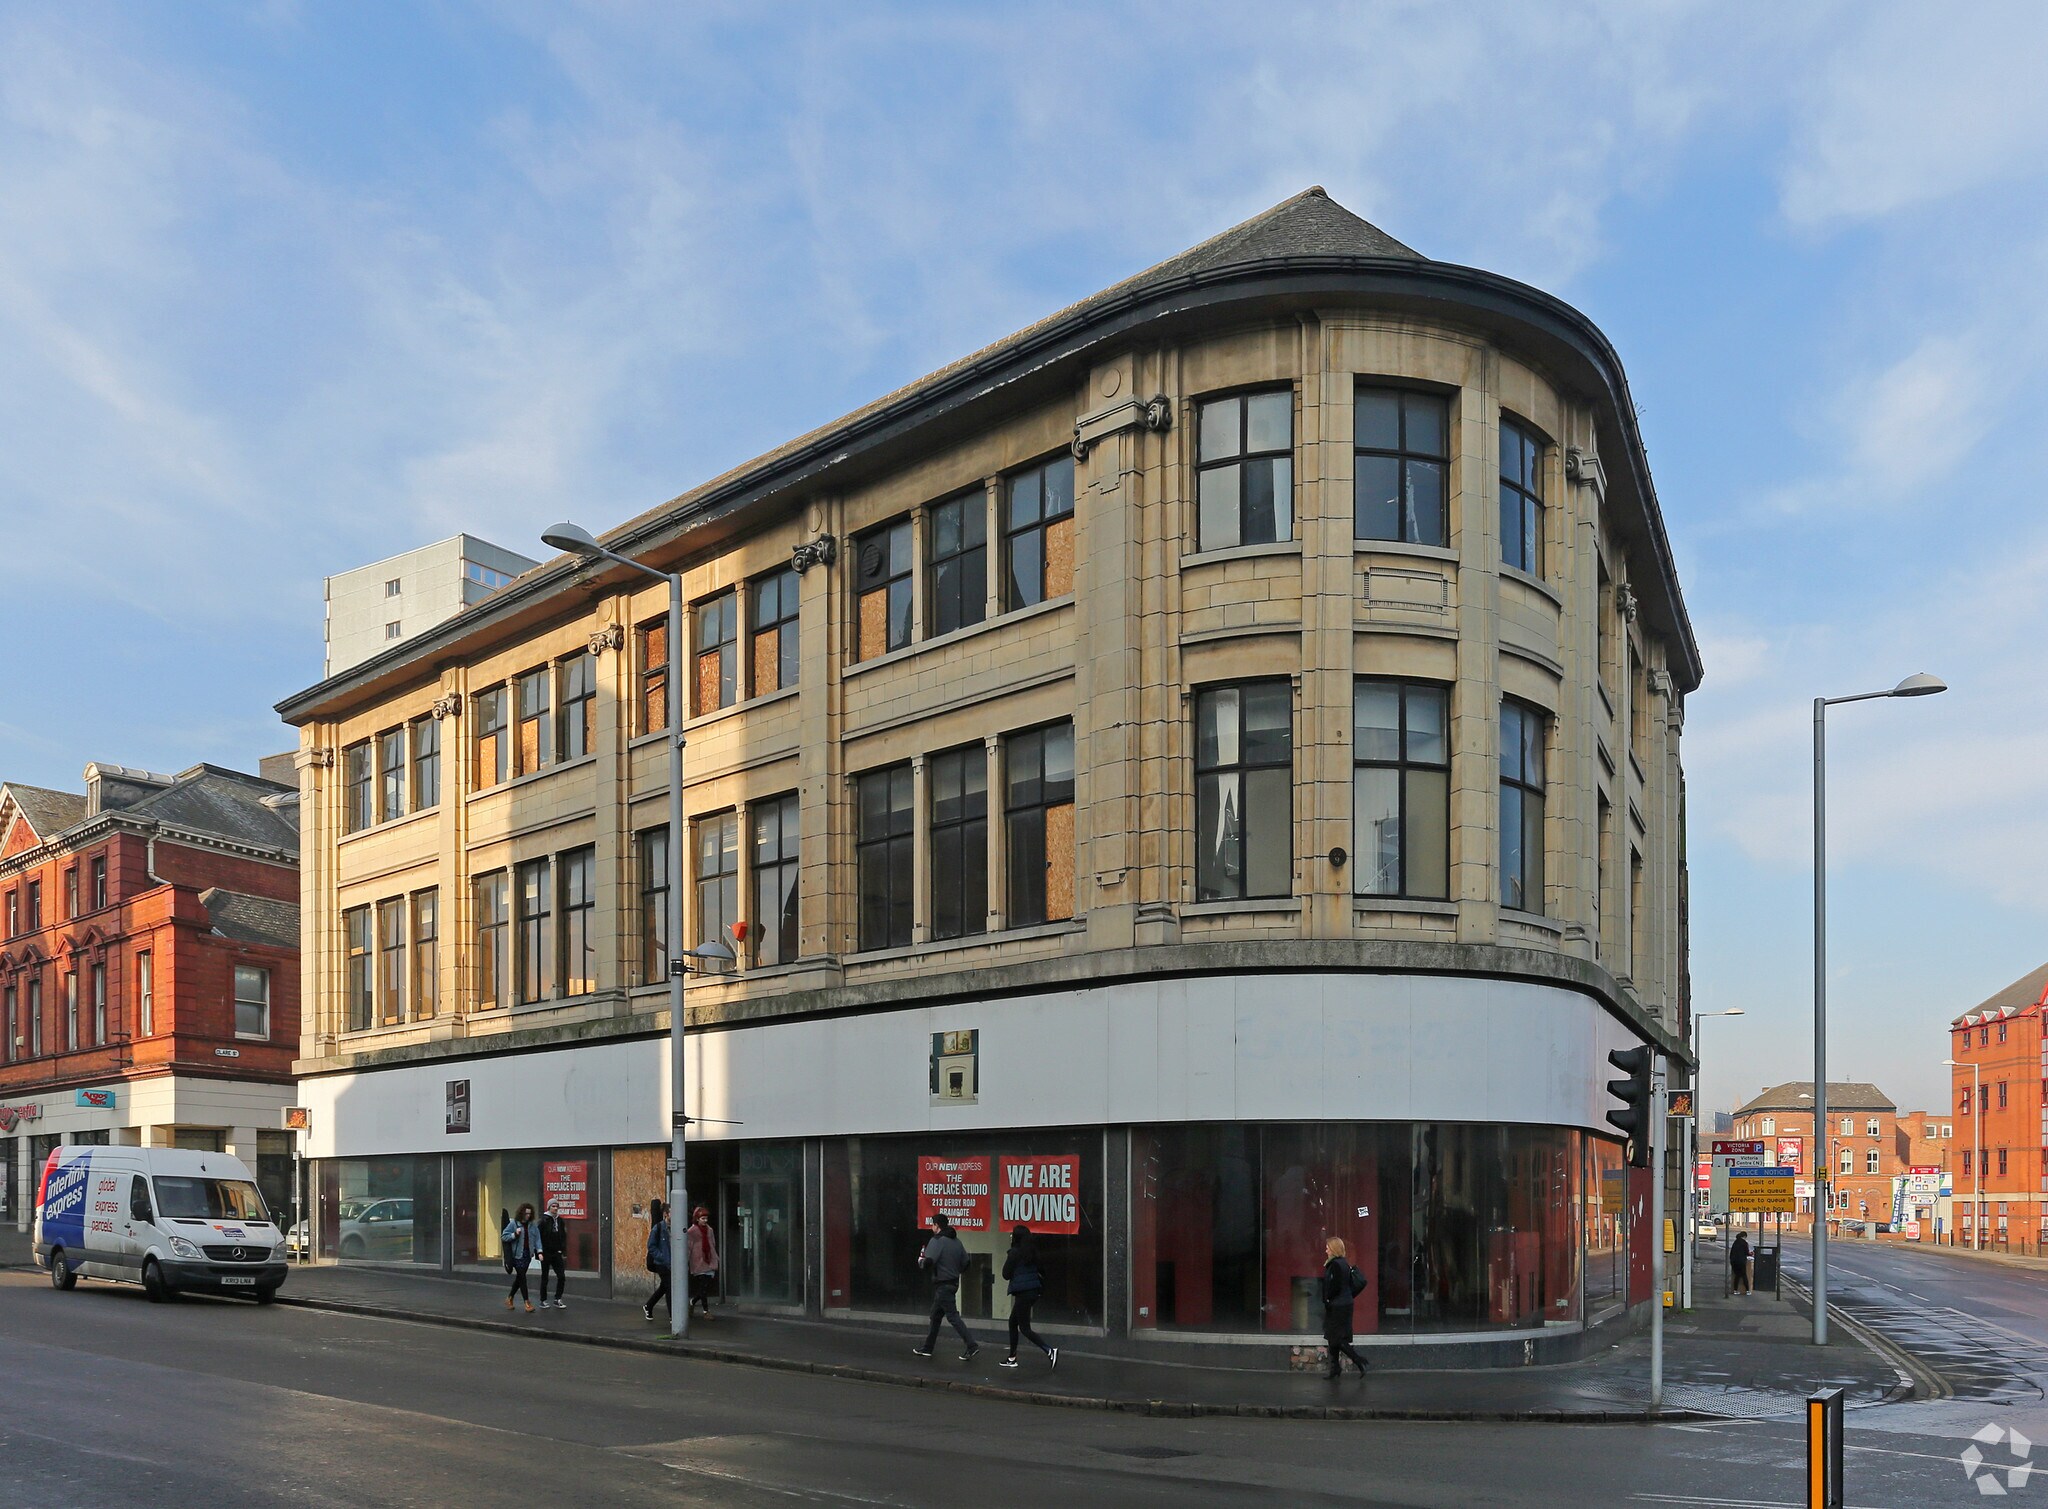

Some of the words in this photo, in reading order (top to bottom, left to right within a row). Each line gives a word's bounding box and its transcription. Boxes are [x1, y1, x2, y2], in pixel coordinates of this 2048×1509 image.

[82, 1091, 108, 1101] Argos
[18, 1105, 37, 1119] extra
[1755, 1144, 1762, 1152] P
[925, 1163, 938, 1171] OUR
[939, 1163, 958, 1171] NEW
[958, 1162, 983, 1171] ADDRESS:
[946, 1174, 963, 1183] THE
[1007, 1164, 1034, 1188] WE
[1038, 1164, 1071, 1188] ARE
[1818, 1168, 1827, 1179] H
[47, 1160, 86, 1202] interlink
[98, 1177, 118, 1195] global
[546, 1182, 569, 1191] FIREPLACE
[570, 1182, 586, 1191] STUDIO
[922, 1183, 960, 1195] FIREPLACE
[961, 1183, 988, 1196] STUDIO
[46, 1185, 83, 1220] express
[95, 1200, 119, 1216] express
[931, 1198, 943, 1207] 213
[944, 1198, 961, 1207] DERBY
[962, 1198, 976, 1207] ROAD
[1003, 1193, 1076, 1223] MOVING
[91, 1218, 113, 1235] parcels
